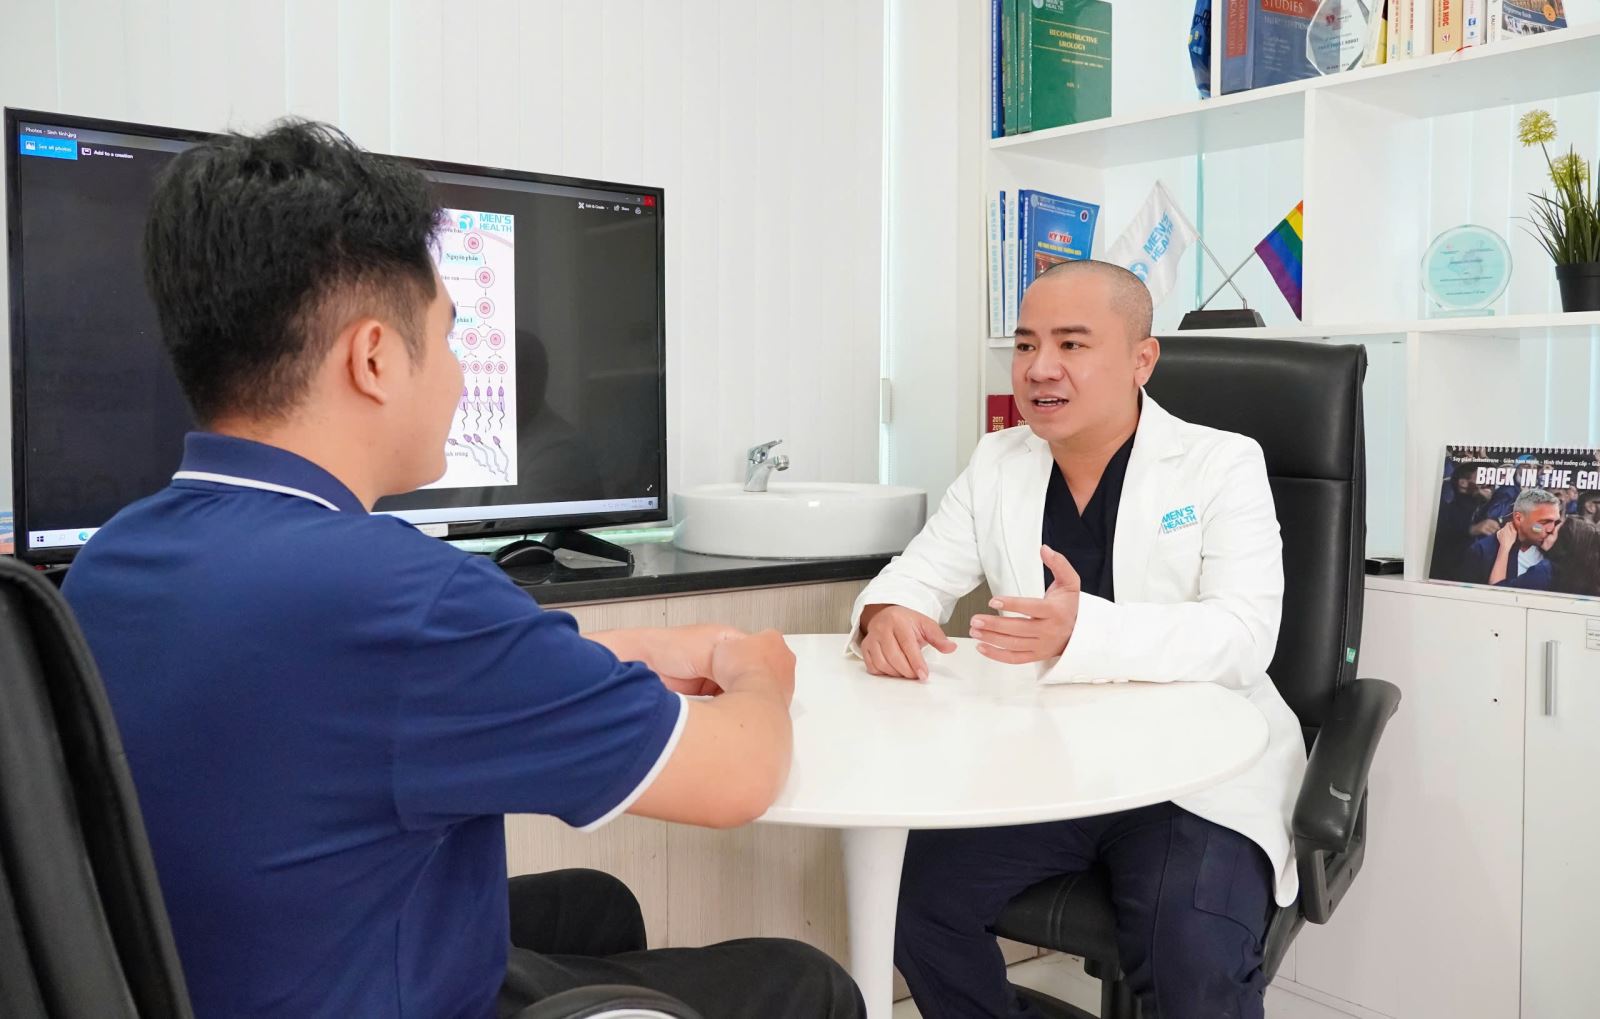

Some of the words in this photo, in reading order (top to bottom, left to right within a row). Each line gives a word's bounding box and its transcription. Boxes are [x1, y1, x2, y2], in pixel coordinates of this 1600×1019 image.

[1264, 0, 1304, 14] STUDIES
[1058, 40, 1086, 51] UROLOGY
[479, 213, 512, 225] MEN'S
[479, 223, 512, 233] HEALTH
[1143, 211, 1169, 255] MEN'S
[1476, 466, 1517, 486] BACK
[1520, 468, 1538, 487] IN
[1542, 469, 1572, 489] THE
[1576, 470, 1600, 490] GA
[1161, 504, 1195, 523] MEN'S
[1163, 514, 1197, 531] HEALTH
